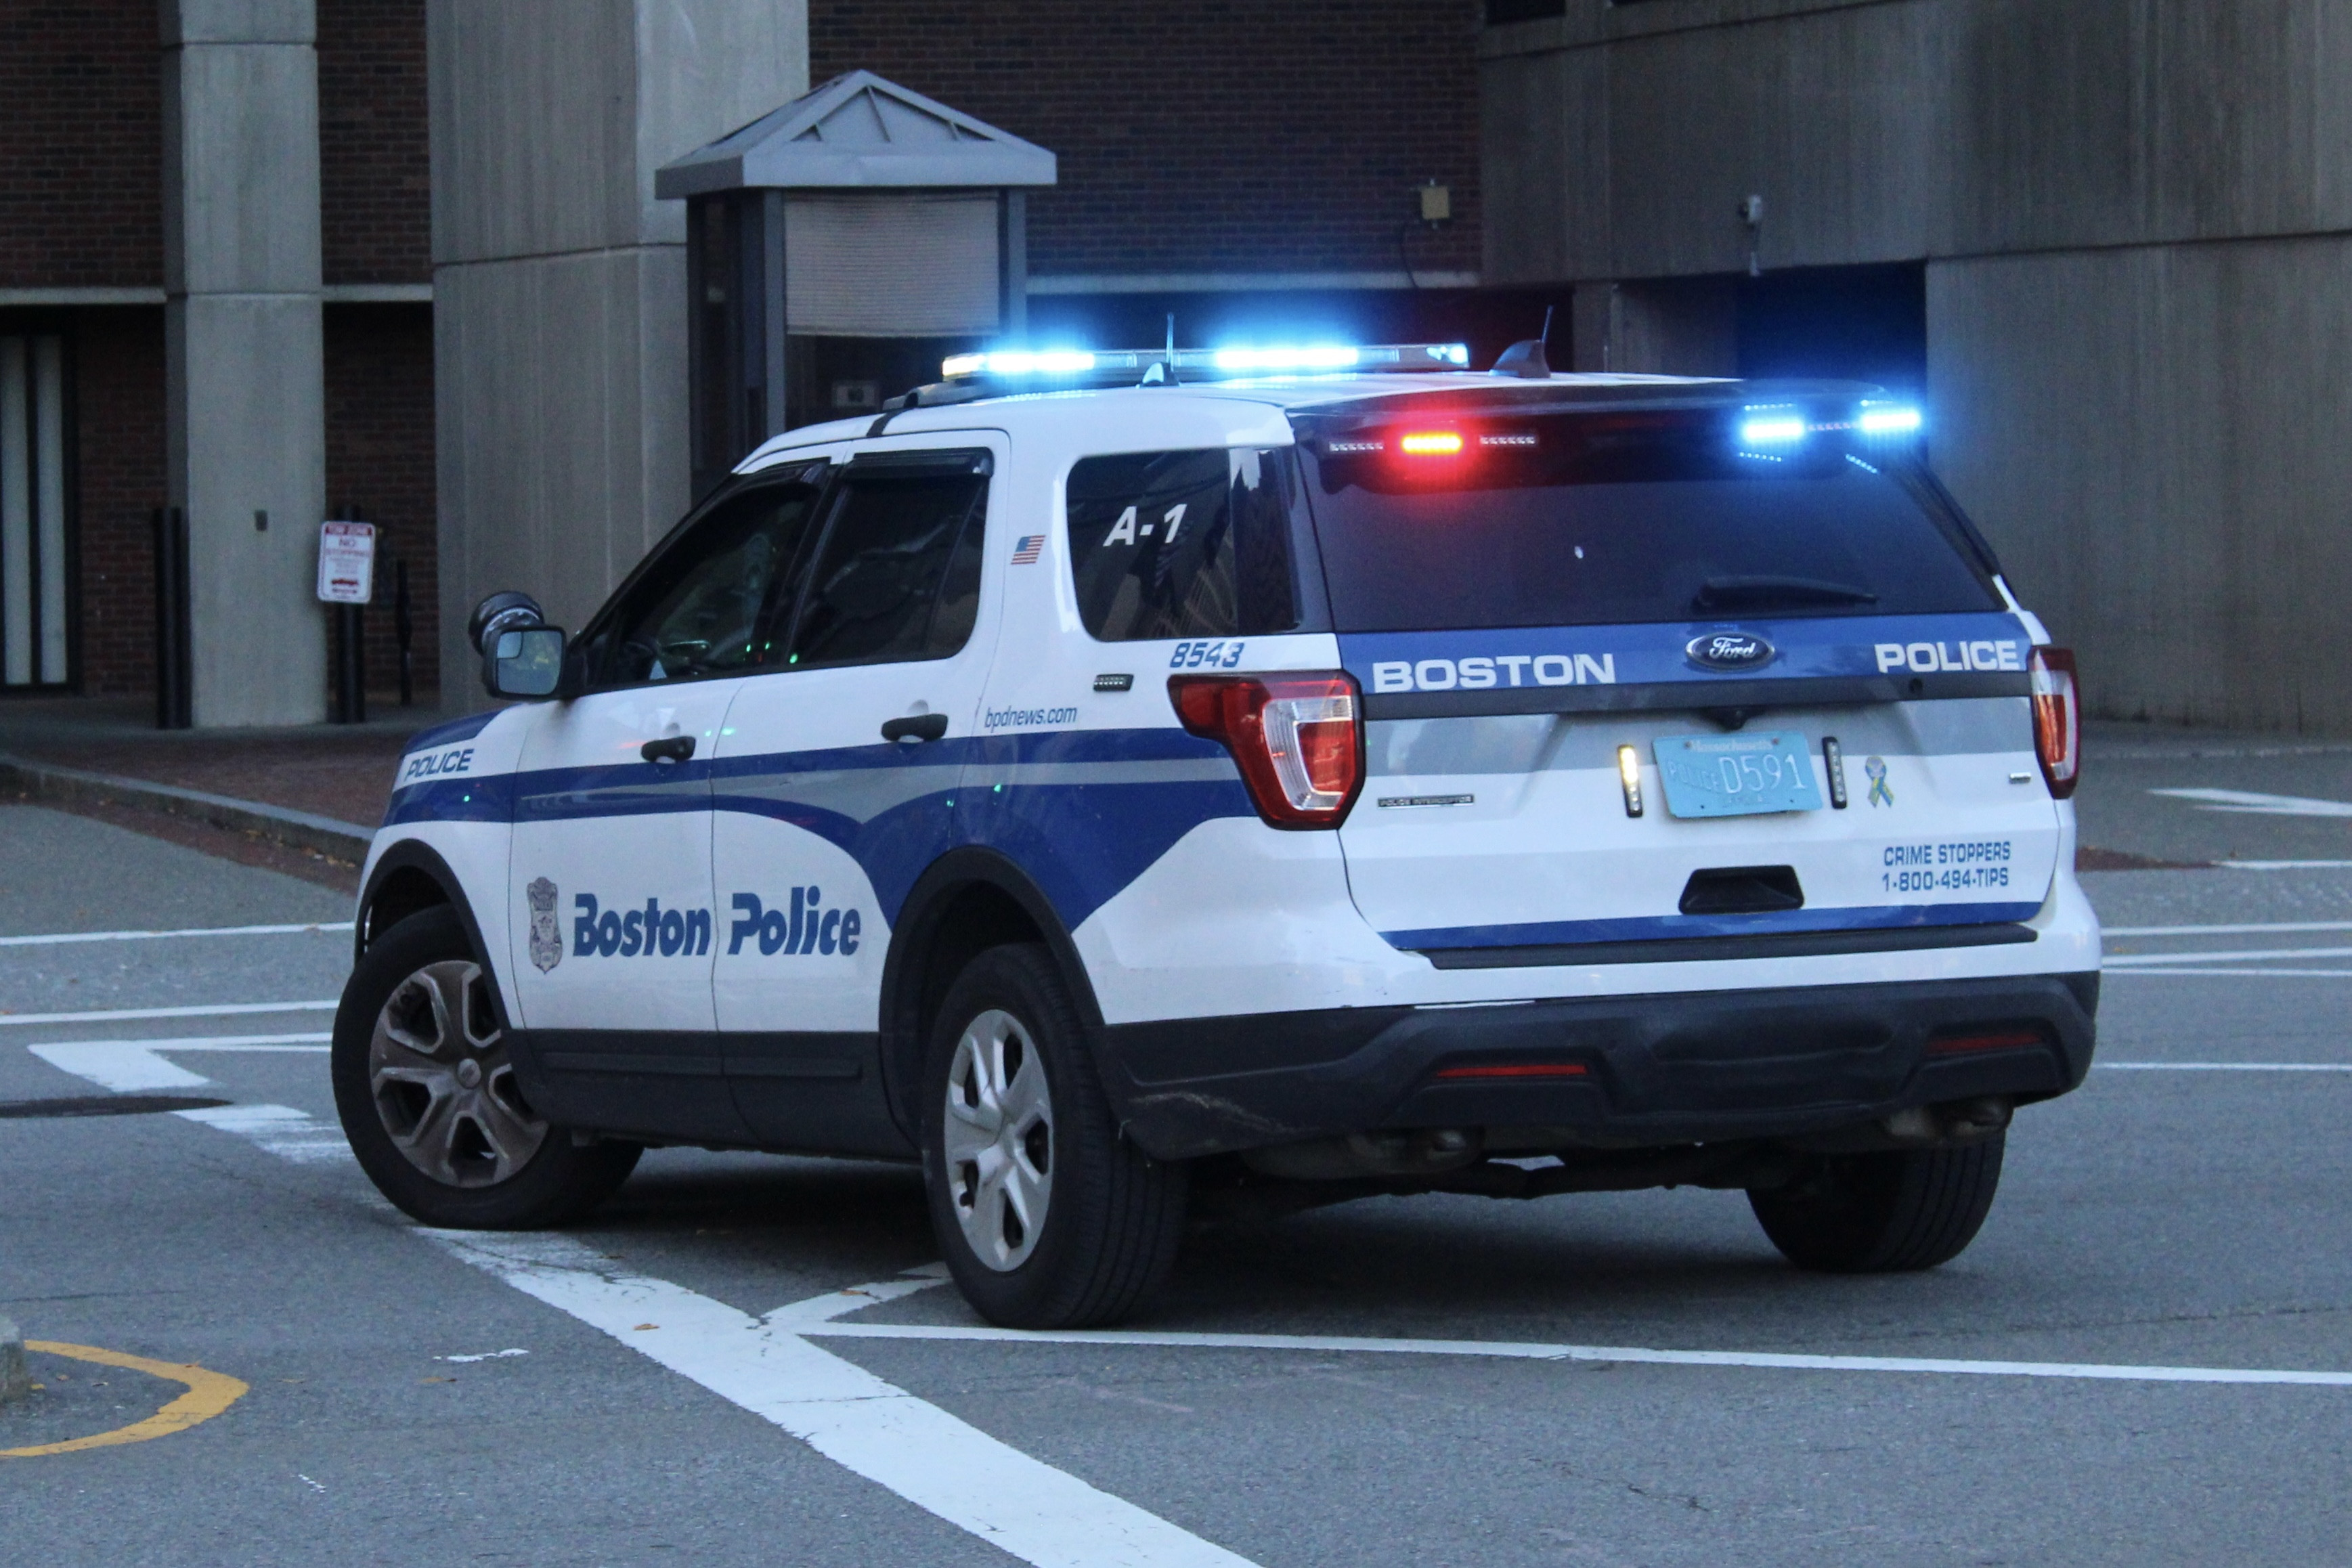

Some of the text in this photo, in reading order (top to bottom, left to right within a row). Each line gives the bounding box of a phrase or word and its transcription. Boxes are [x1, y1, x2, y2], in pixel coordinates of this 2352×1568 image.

[1103, 504, 1187, 547] A-1
[1169, 643, 1244, 668] 8543
[1709, 636, 1756, 659] Ford
[1875, 640, 2020, 674] POLICE
[1373, 653, 1615, 693] BOSTON
[984, 705, 1078, 733] bpdnews.com
[405, 748, 474, 781] POLICE
[1718, 754, 1808, 794] D591
[1884, 842, 2011, 866] CRIME STOPPERS
[1882, 867, 2009, 892] 1-800-494-TIPS
[573, 886, 861, 957] Boston Police
